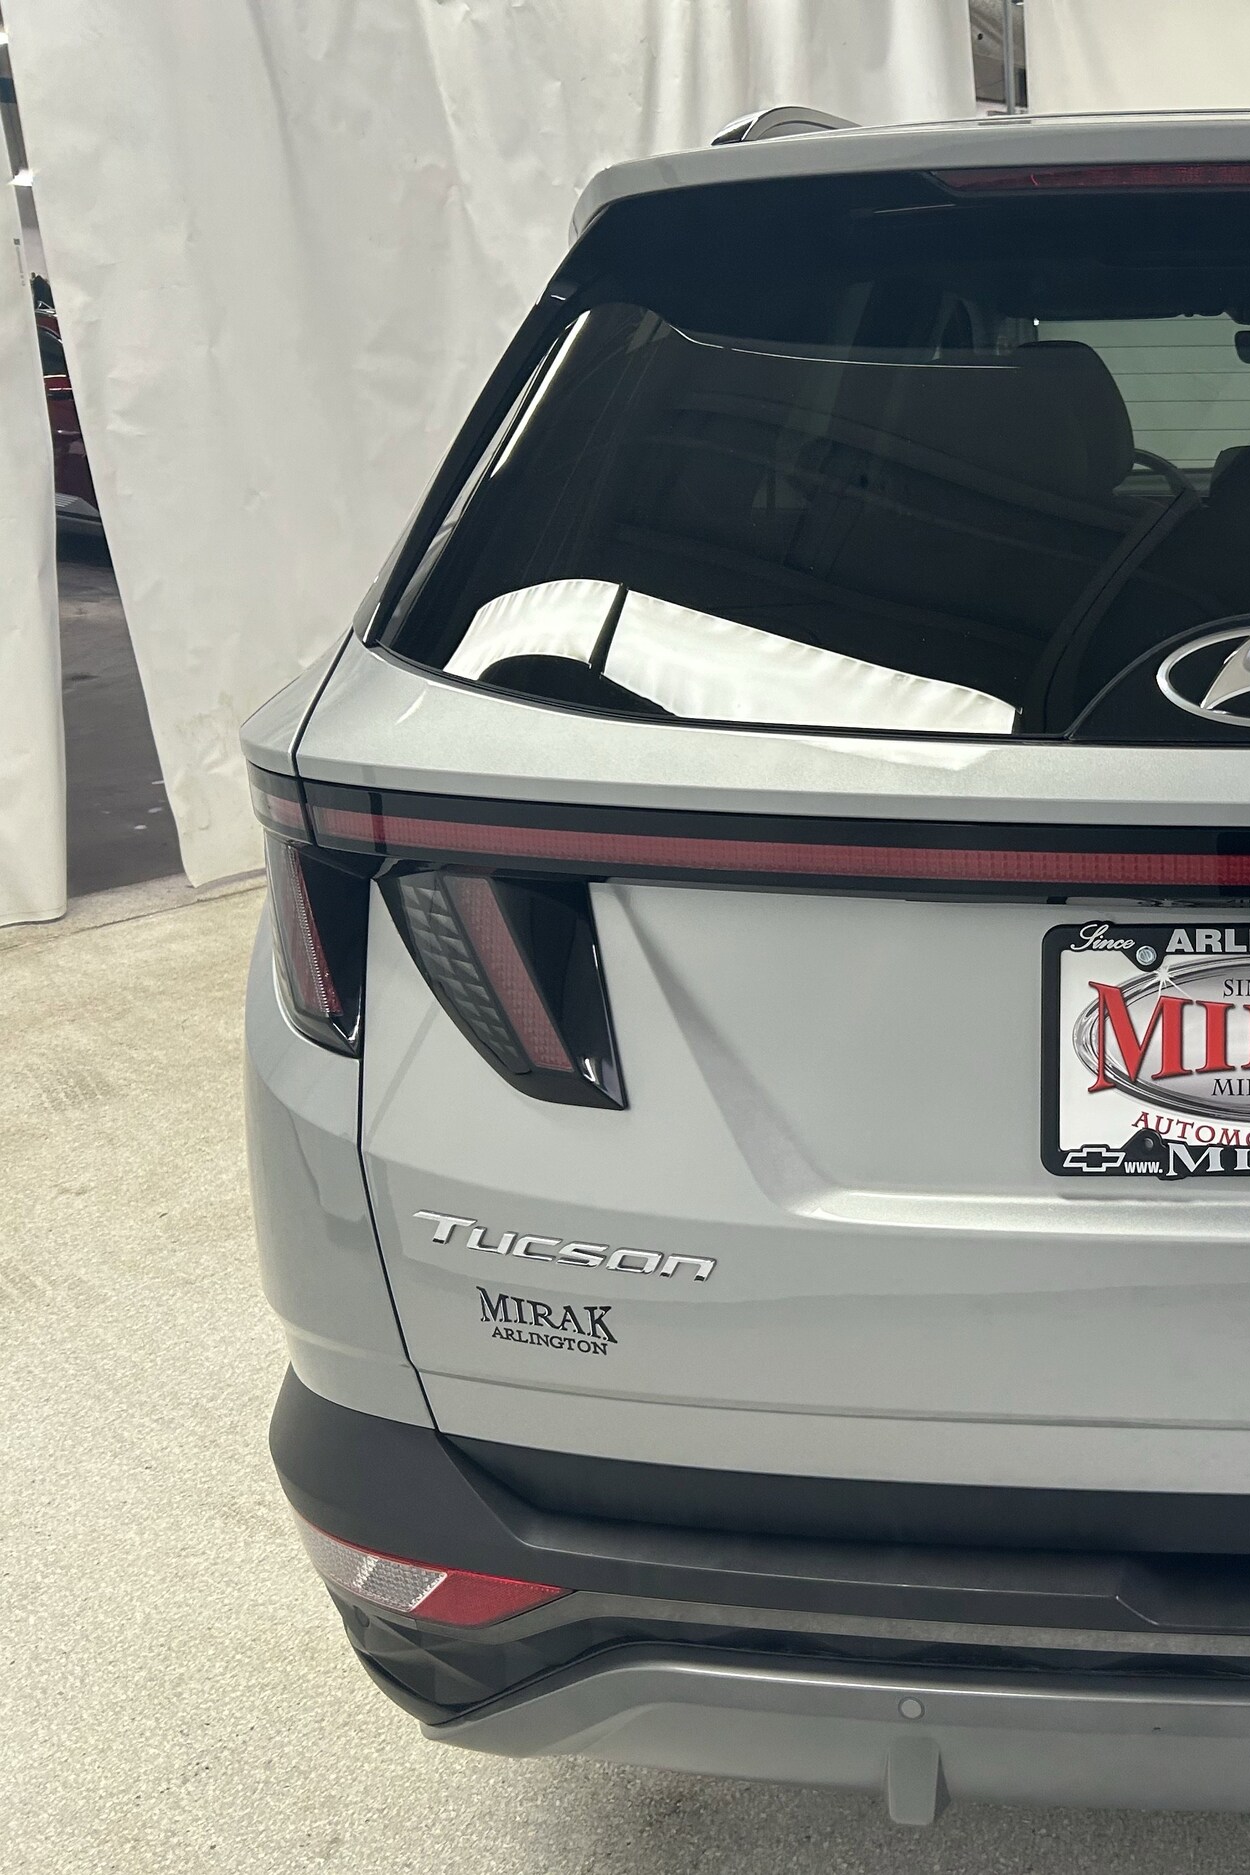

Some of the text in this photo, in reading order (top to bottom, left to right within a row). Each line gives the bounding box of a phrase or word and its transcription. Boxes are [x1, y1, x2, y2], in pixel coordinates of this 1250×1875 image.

[1070, 924, 1136, 951] Since
[476, 1286, 618, 1344] MIRAK
[492, 1327, 609, 1356] ARLINGTON
